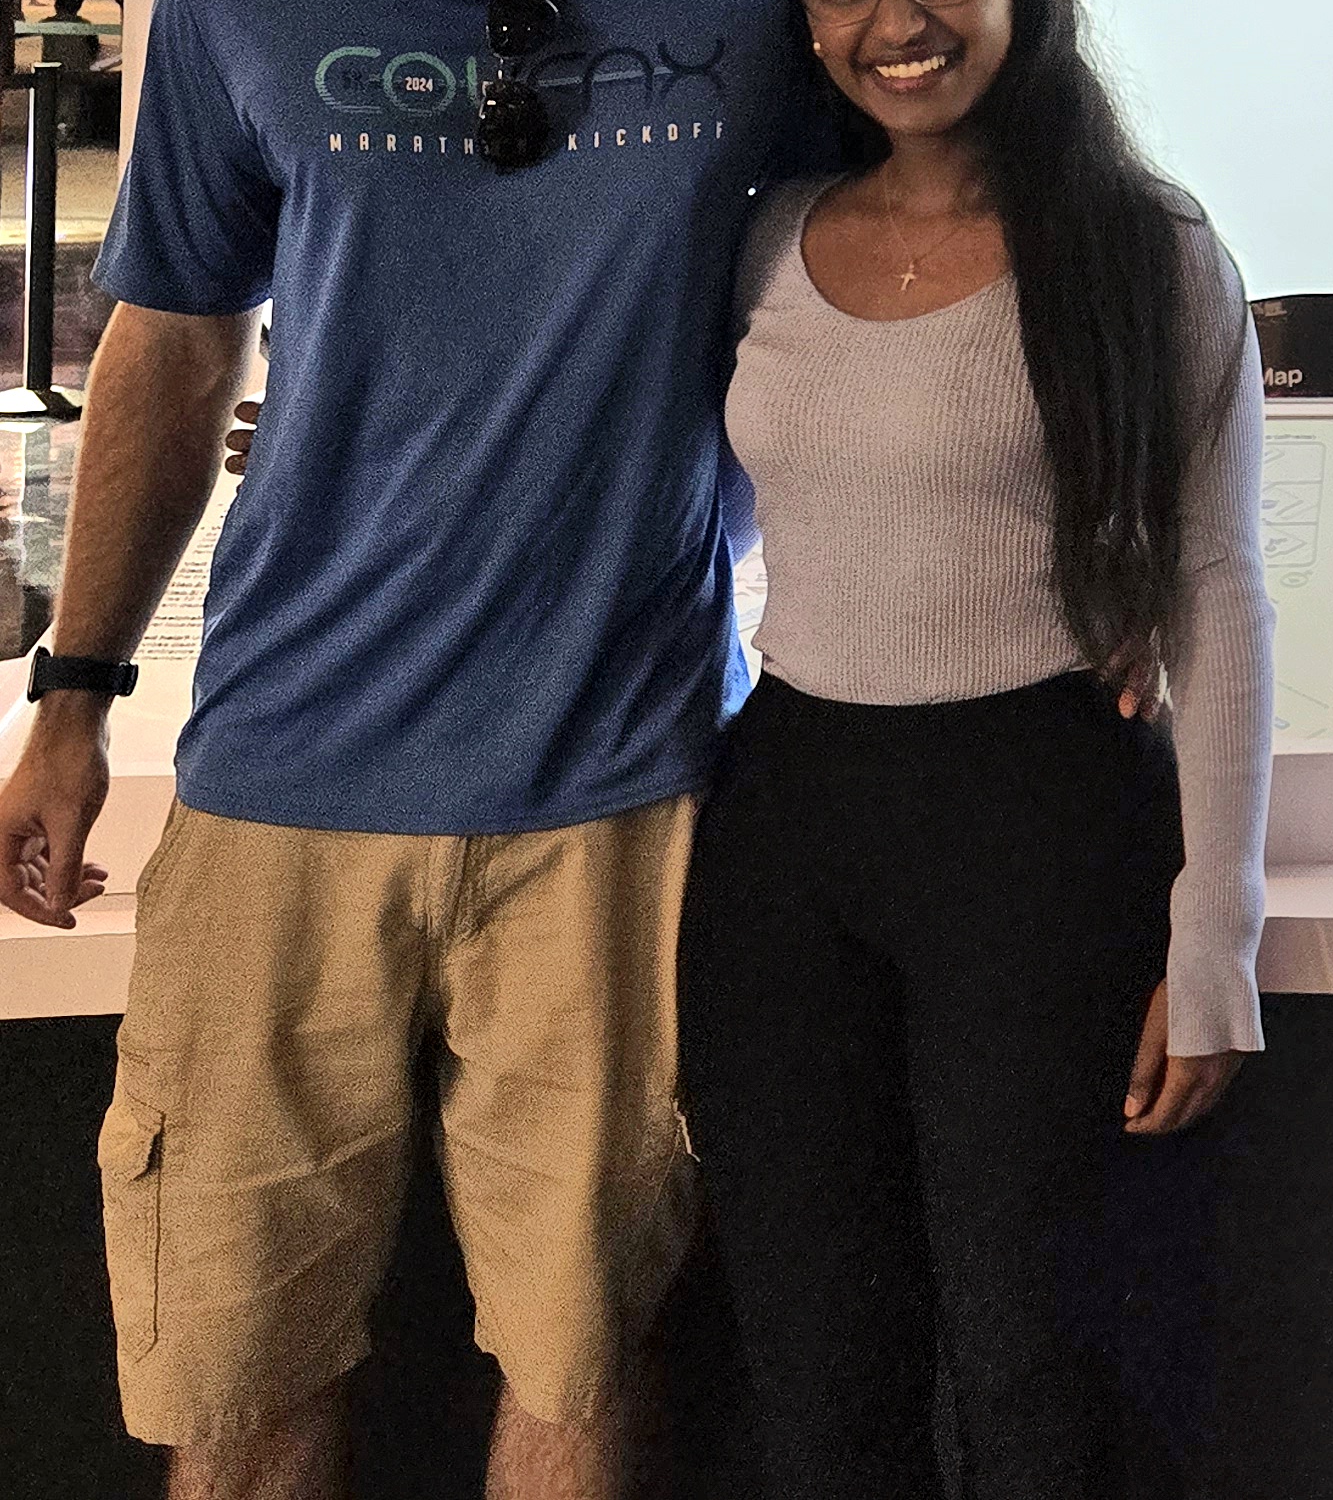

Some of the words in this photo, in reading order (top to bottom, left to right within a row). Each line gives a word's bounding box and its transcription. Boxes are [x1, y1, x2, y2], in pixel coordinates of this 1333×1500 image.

[405, 76, 433, 92] 2024
[329, 132, 491, 156] MARATH
[567, 121, 725, 152] KICKOFF
